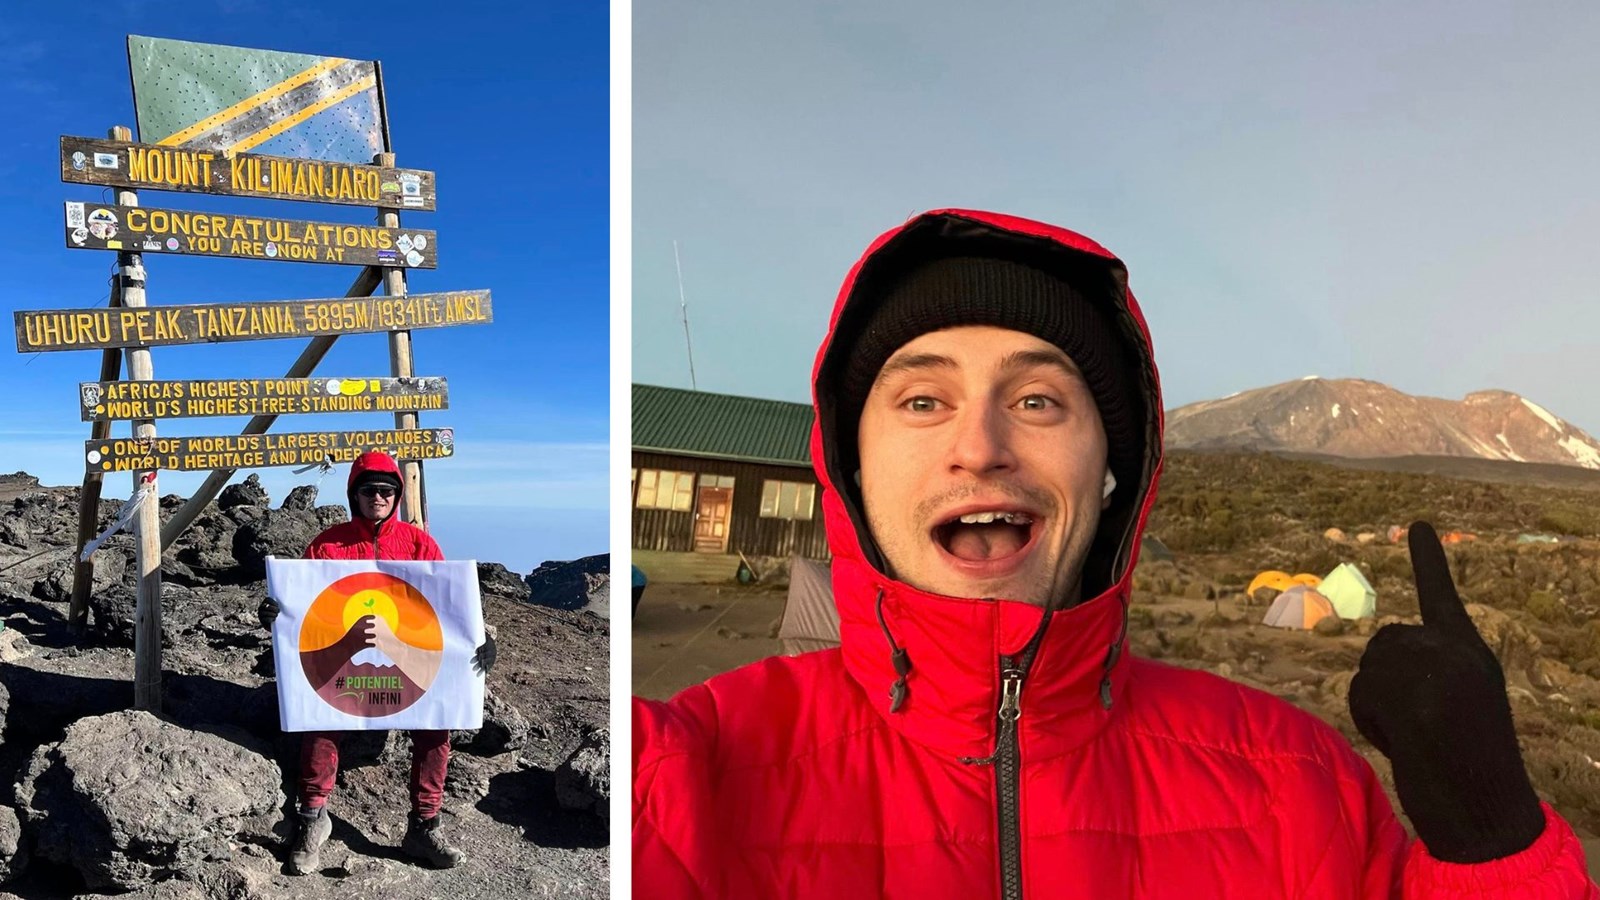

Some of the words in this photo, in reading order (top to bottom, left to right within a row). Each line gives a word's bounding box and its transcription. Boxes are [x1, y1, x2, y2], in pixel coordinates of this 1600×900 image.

[128, 148, 214, 187] MOUNT
[231, 158, 380, 200] KILIMANJARO
[127, 209, 392, 249] CONGRATULATIONS
[187, 236, 221, 252] YOU
[231, 240, 264, 256] ARE
[278, 244, 317, 260] NOW
[326, 247, 345, 261] AT
[25, 312, 111, 346] UHURU
[120, 310, 188, 341] PEAK,
[193, 305, 300, 338] TANZANIA,
[445, 295, 486, 321] AMSL
[108, 382, 184, 399] AFRICA'S
[190, 381, 259, 398] HIGHEST
[265, 380, 310, 395] POINT
[107, 399, 181, 418] WORLD'S
[187, 398, 258, 415] HIGHEST
[376, 395, 442, 410] MOUNTAIN
[114, 441, 149, 456] ONE
[158, 440, 180, 454] OF
[188, 436, 259, 453] WORLD'S
[266, 434, 337, 450] LARGEST
[344, 431, 432, 446] VOLCANOES
[114, 455, 180, 471] WORLD
[185, 452, 264, 469] HERITAGE
[270, 451, 297, 465] AND
[396, 445, 443, 459] AFRICA
[335, 676, 404, 689] #POTENTIEL
[368, 692, 401, 705] INFINI
